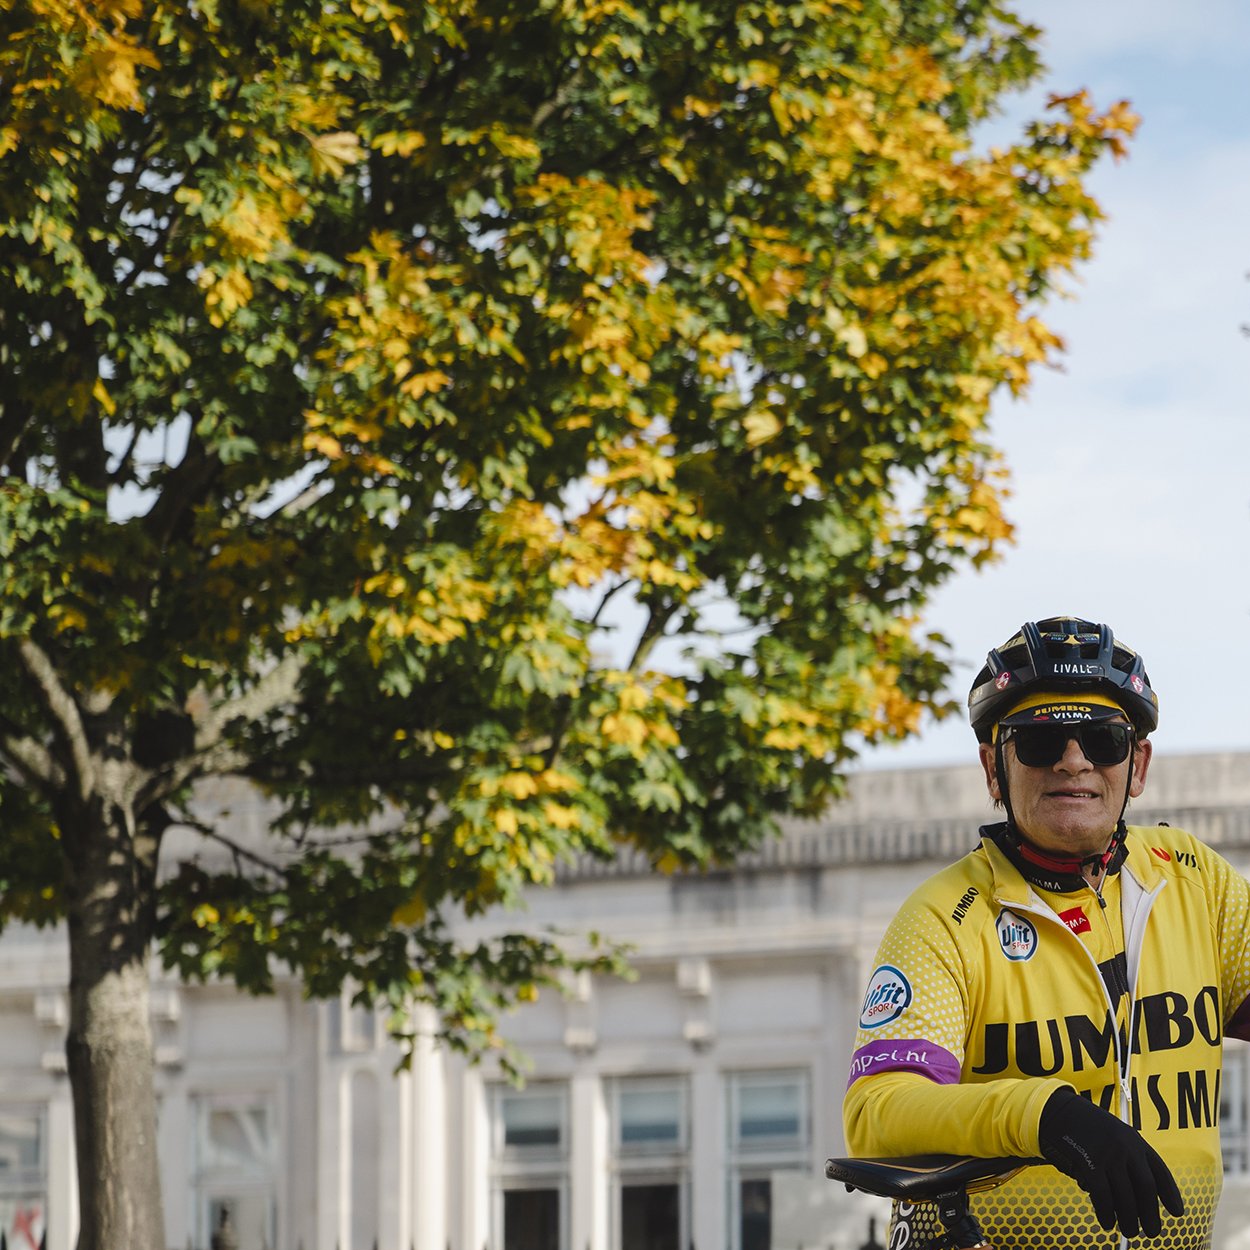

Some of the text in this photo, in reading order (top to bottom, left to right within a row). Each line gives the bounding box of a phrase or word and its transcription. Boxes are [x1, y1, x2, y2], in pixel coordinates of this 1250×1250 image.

[1053, 663, 1093, 674] LIVALL
[1032, 705, 1092, 717] JUMBO
[1053, 712, 1093, 720] VISMA
[1174, 849, 1201, 872] VIS
[951, 886, 980, 926] JUMBO
[1064, 917, 1087, 930] EMA
[867, 1002, 895, 1017] SPORT
[971, 985, 1221, 1077] JUMBO
